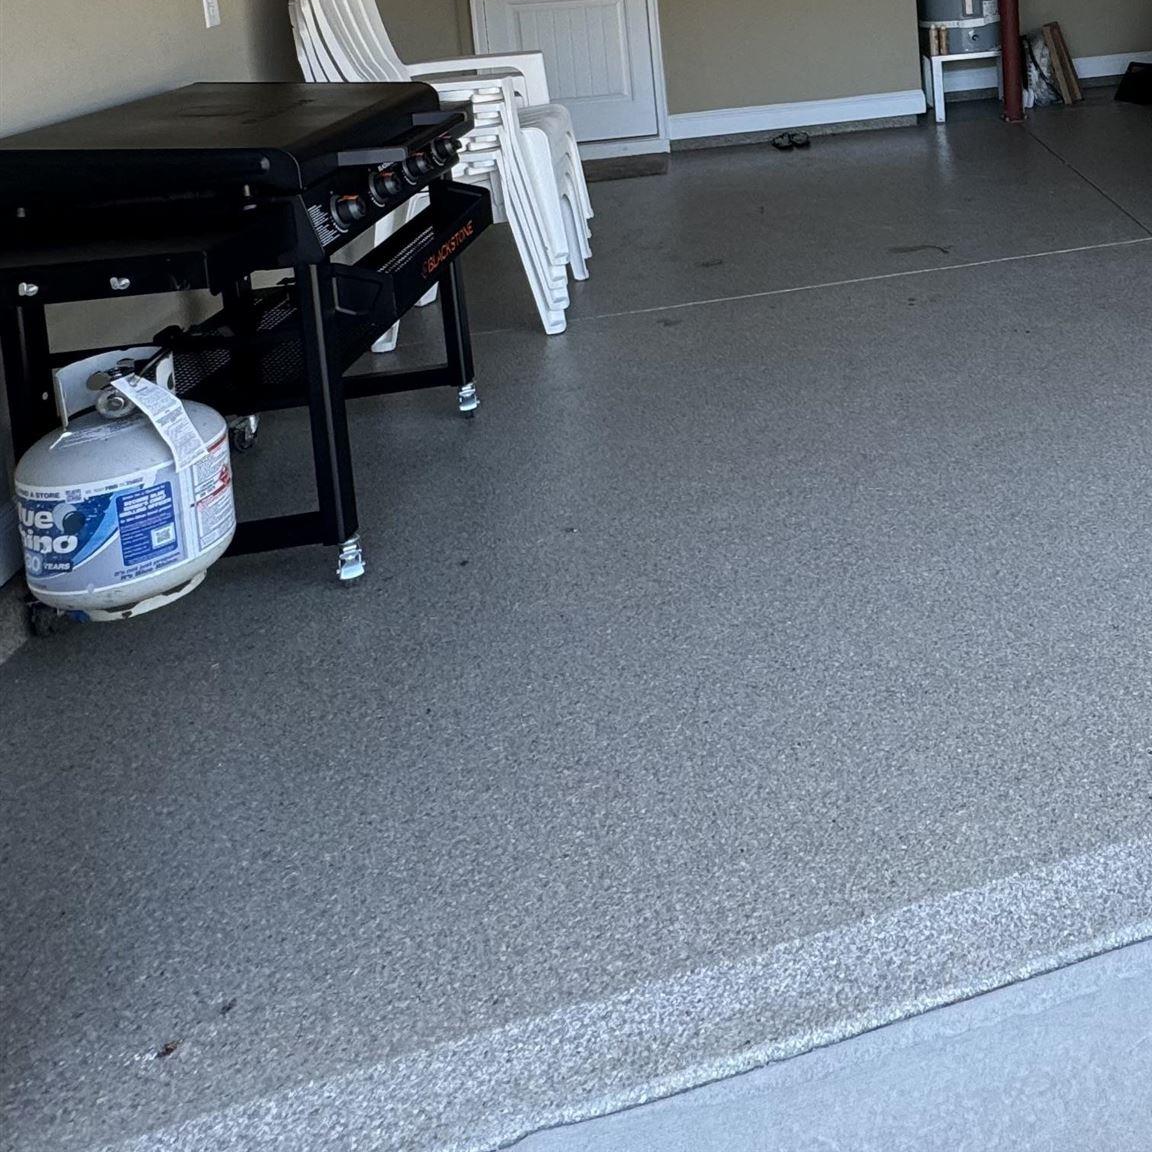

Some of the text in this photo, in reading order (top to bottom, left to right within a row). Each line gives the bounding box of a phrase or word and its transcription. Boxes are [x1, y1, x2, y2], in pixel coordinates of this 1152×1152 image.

[428, 220, 473, 273] BLACKSTONE
[18, 503, 53, 529] ue
[43, 562, 71, 571] YEARS
